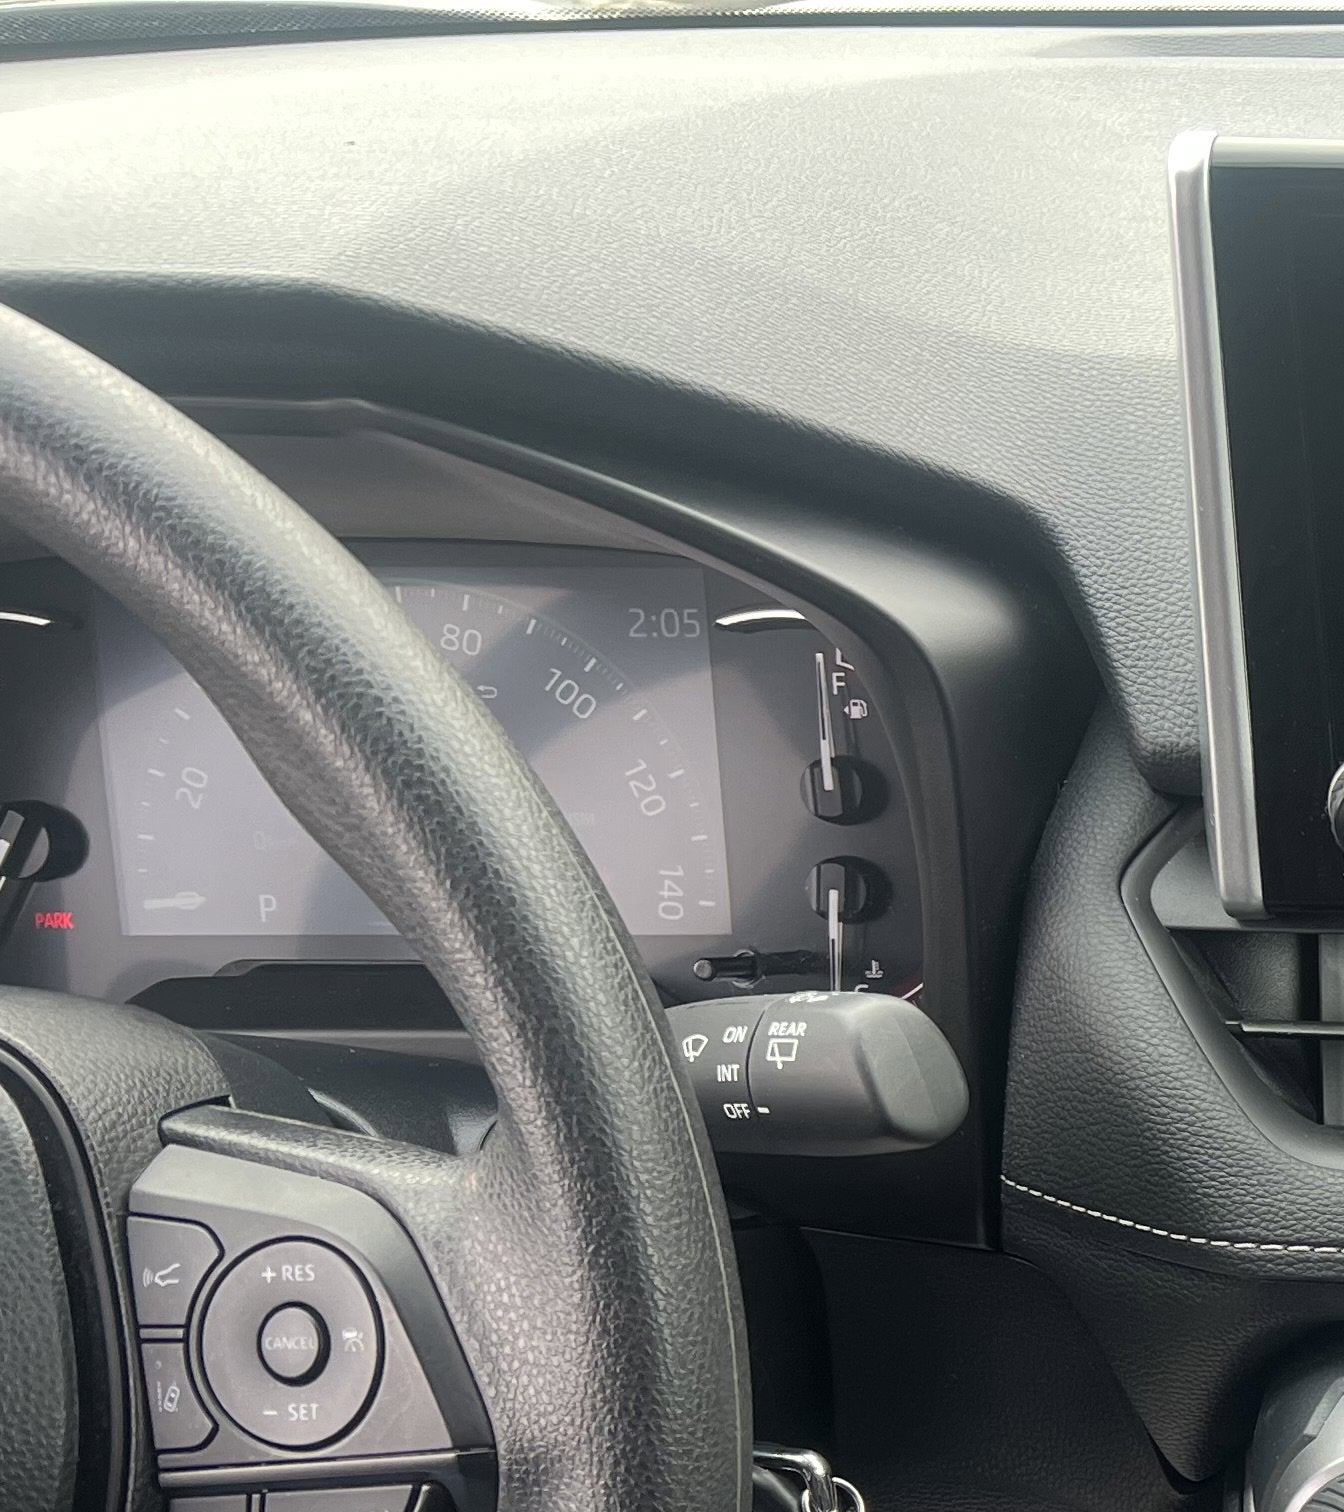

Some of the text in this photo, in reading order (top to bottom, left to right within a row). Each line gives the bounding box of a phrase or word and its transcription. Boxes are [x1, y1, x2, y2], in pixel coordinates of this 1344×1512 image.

[628, 608, 700, 638] 2:05
[439, 623, 482, 656] 80
[544, 668, 597, 719] 100
[832, 671, 846, 695] F
[175, 766, 208, 809] 20
[624, 759, 666, 816] 120
[658, 865, 684, 920] 140
[258, 894, 278, 922] P
[34, 911, 74, 930] PARK
[722, 1025, 748, 1044] ON
[768, 1021, 807, 1037] REAR
[716, 1064, 741, 1082] INT
[723, 1103, 751, 1120] OFF
[282, 1265, 316, 1281] RES
[288, 1404, 318, 1421] SET
